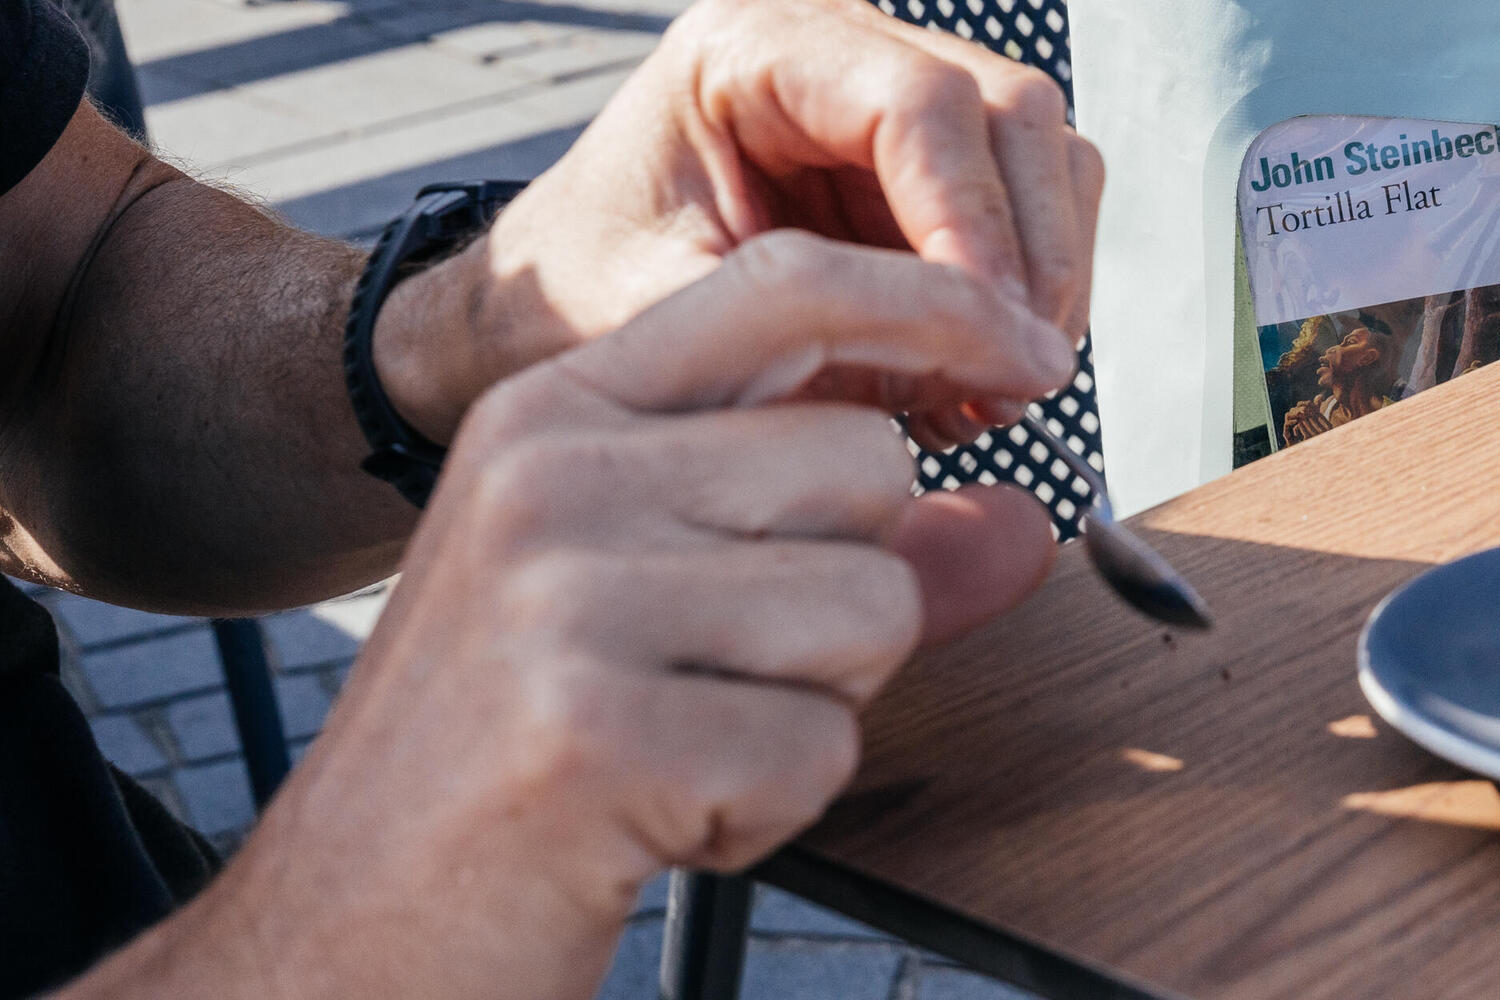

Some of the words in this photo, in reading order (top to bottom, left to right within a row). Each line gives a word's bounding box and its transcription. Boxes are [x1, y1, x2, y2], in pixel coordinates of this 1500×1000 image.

[1250, 151, 1335, 193] John
[1256, 190, 1374, 236] Tortilla
[1381, 180, 1442, 215] Flat
